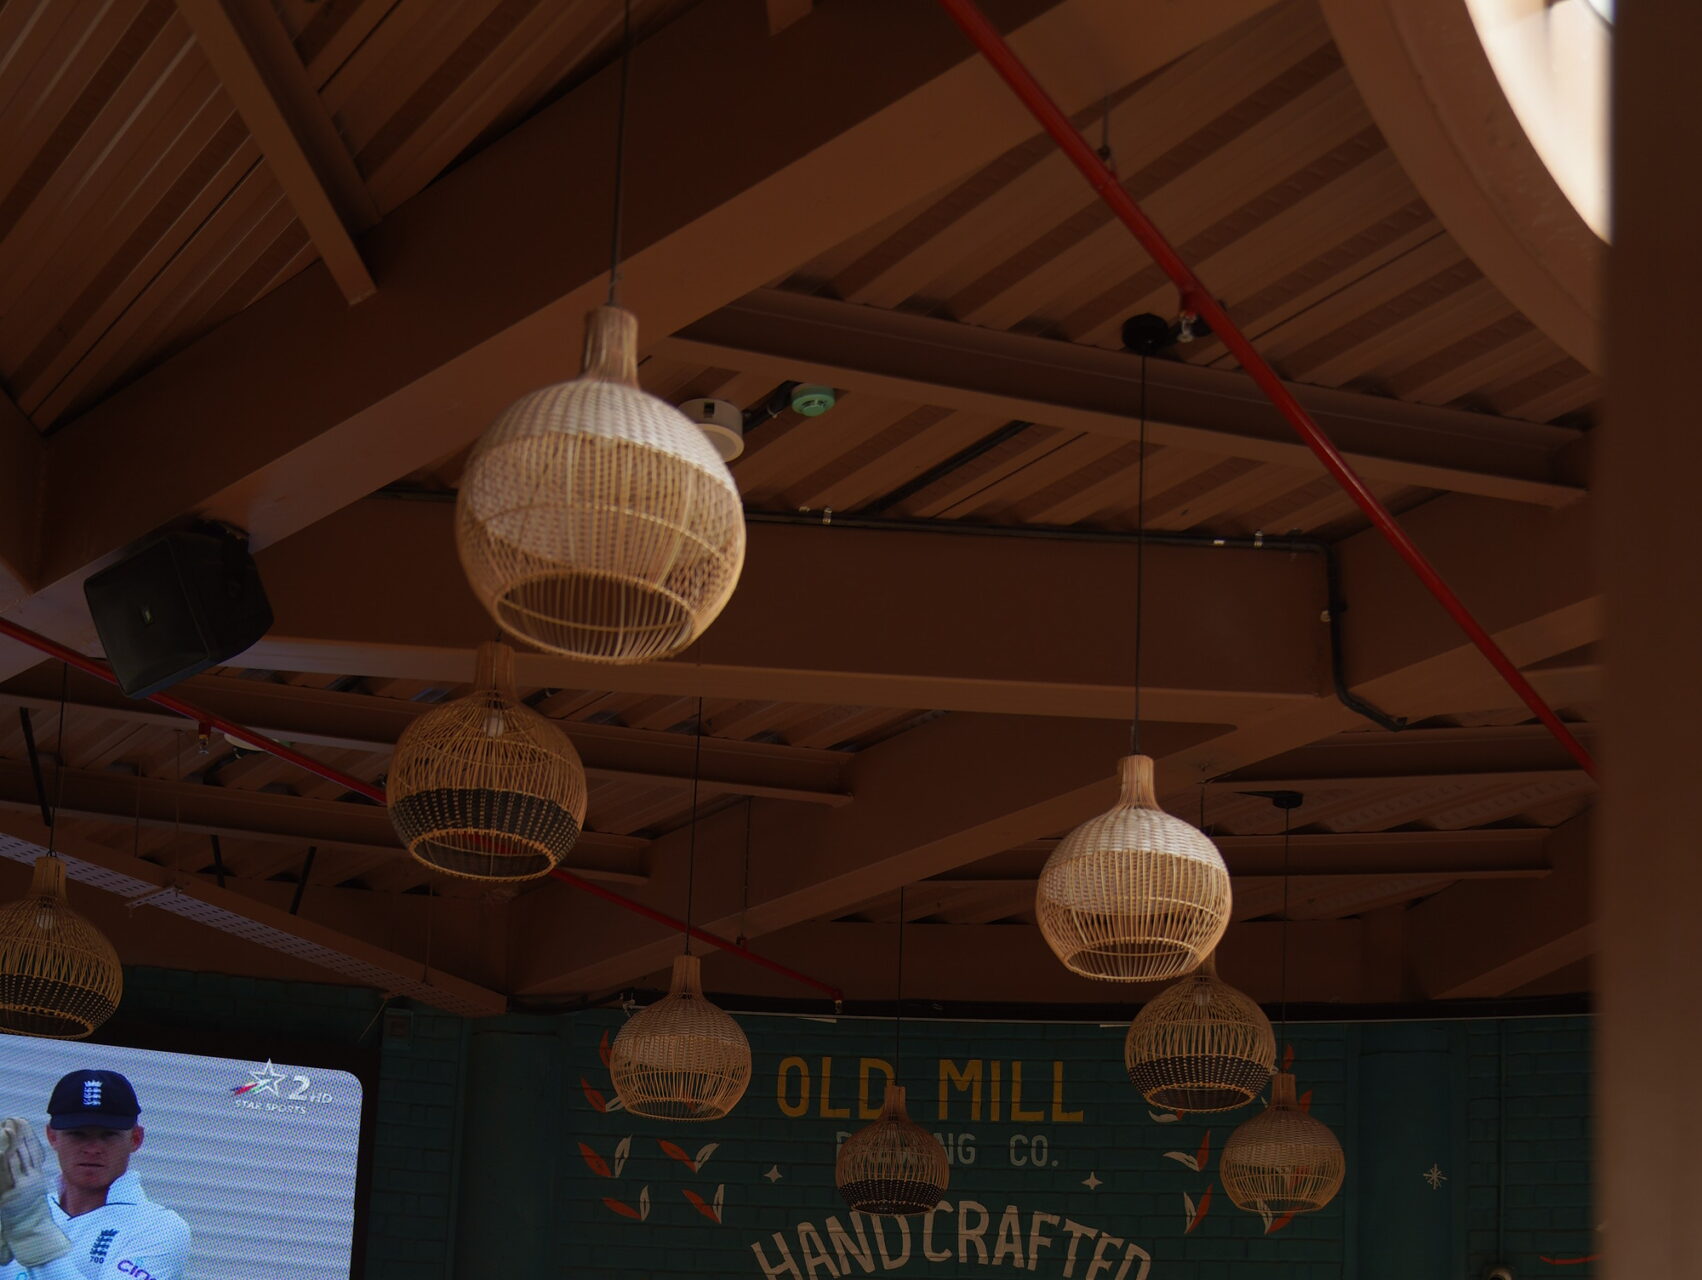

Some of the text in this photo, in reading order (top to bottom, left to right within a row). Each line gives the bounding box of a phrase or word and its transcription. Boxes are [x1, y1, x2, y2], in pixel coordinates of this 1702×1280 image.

[289, 1075, 310, 1100] 2
[776, 1057, 1085, 1123] OLD MILL
[1009, 1133, 1059, 1167] CO.
